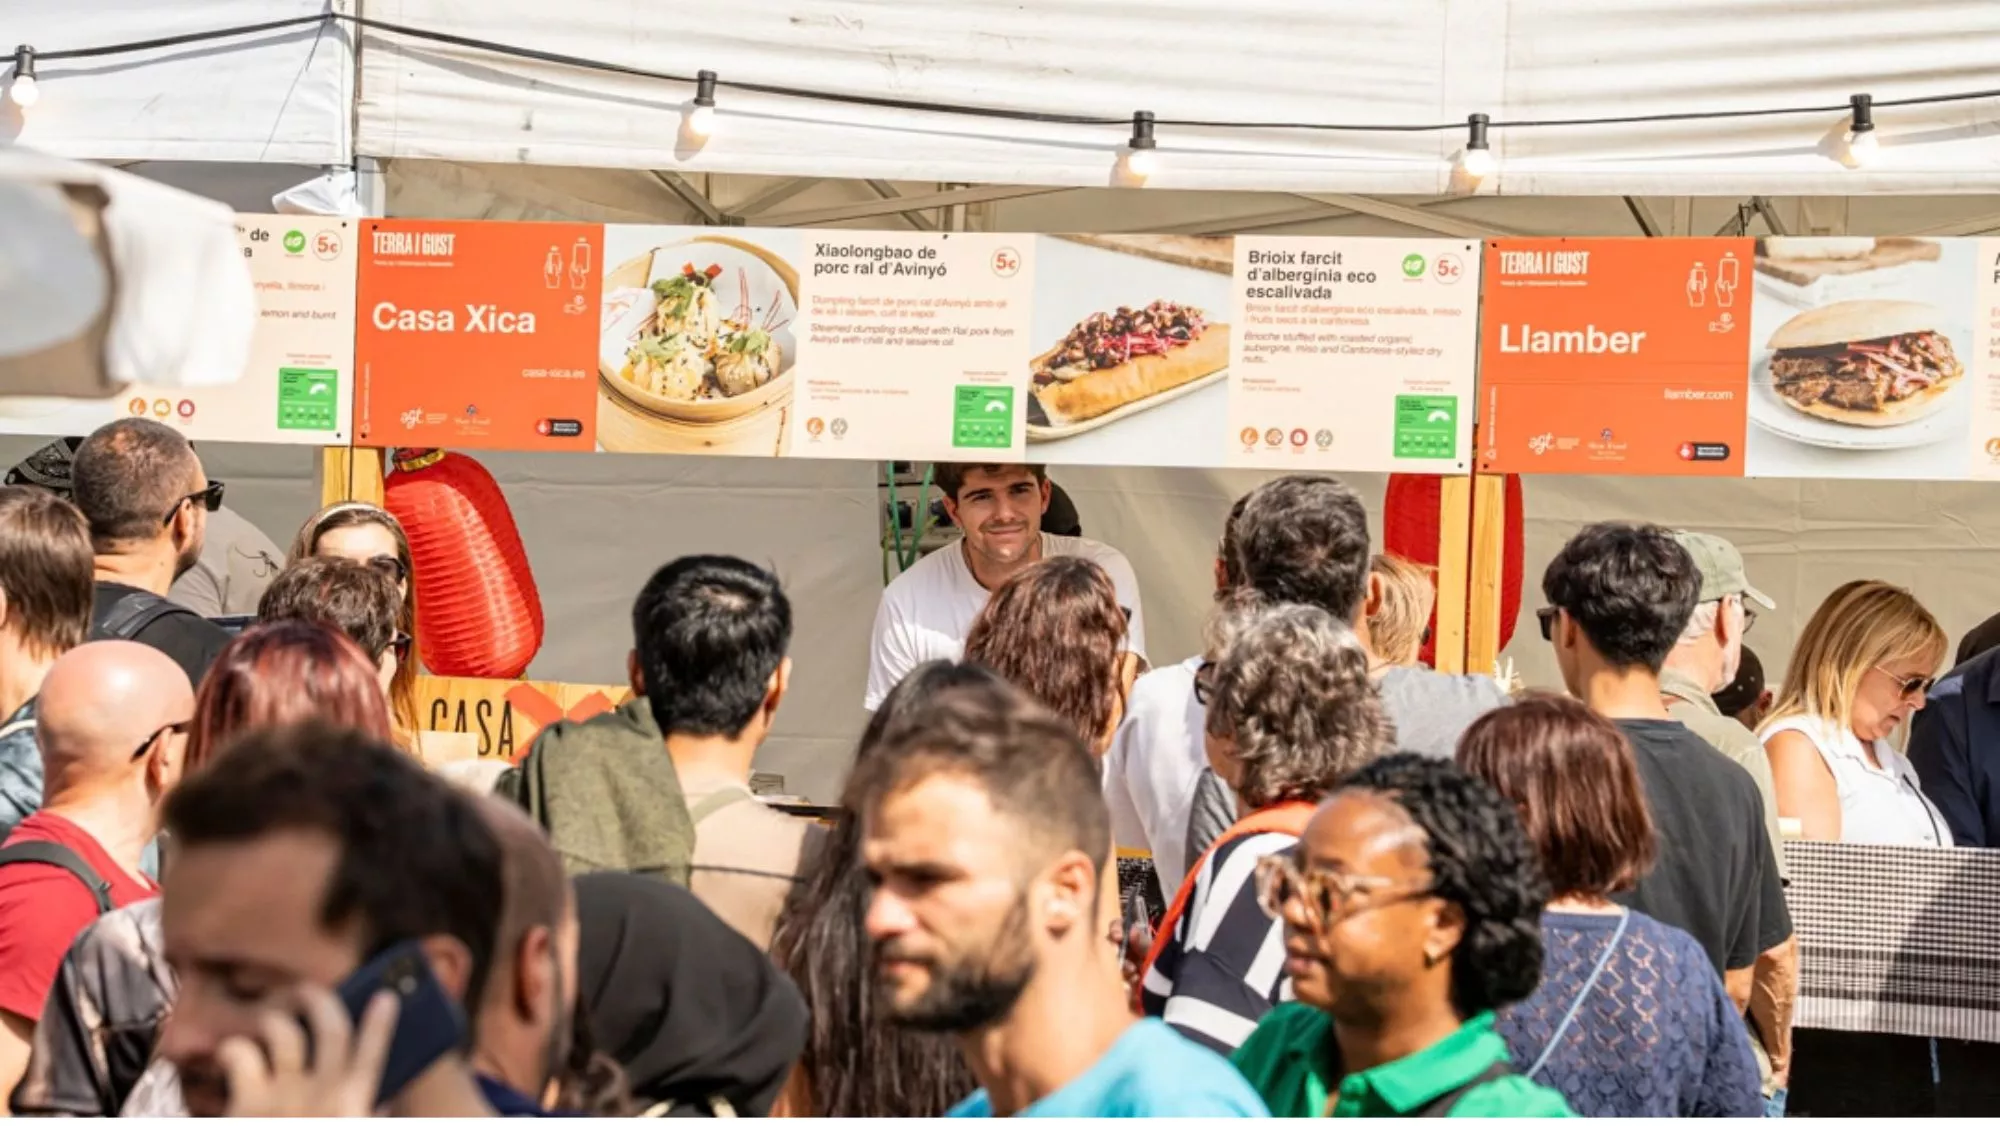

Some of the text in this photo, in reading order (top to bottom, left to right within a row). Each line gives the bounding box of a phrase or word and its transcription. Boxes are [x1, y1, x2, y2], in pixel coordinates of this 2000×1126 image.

[250, 228, 269, 242] de
[372, 232, 456, 256] TERRA I GUST
[815, 243, 936, 260] Xiaolongbao de
[1248, 250, 1343, 265] Brioix farcit
[1500, 251, 1590, 275] TERRA I GUST
[814, 262, 947, 280] porc ral d'Avinyó
[1347, 272, 1377, 283] eco
[1246, 284, 1332, 299] escalivada
[372, 302, 536, 333] Casa Xica
[1500, 324, 1646, 354] Llamber
[1664, 388, 1734, 400] llamber.com
[431, 699, 514, 757] CASA
